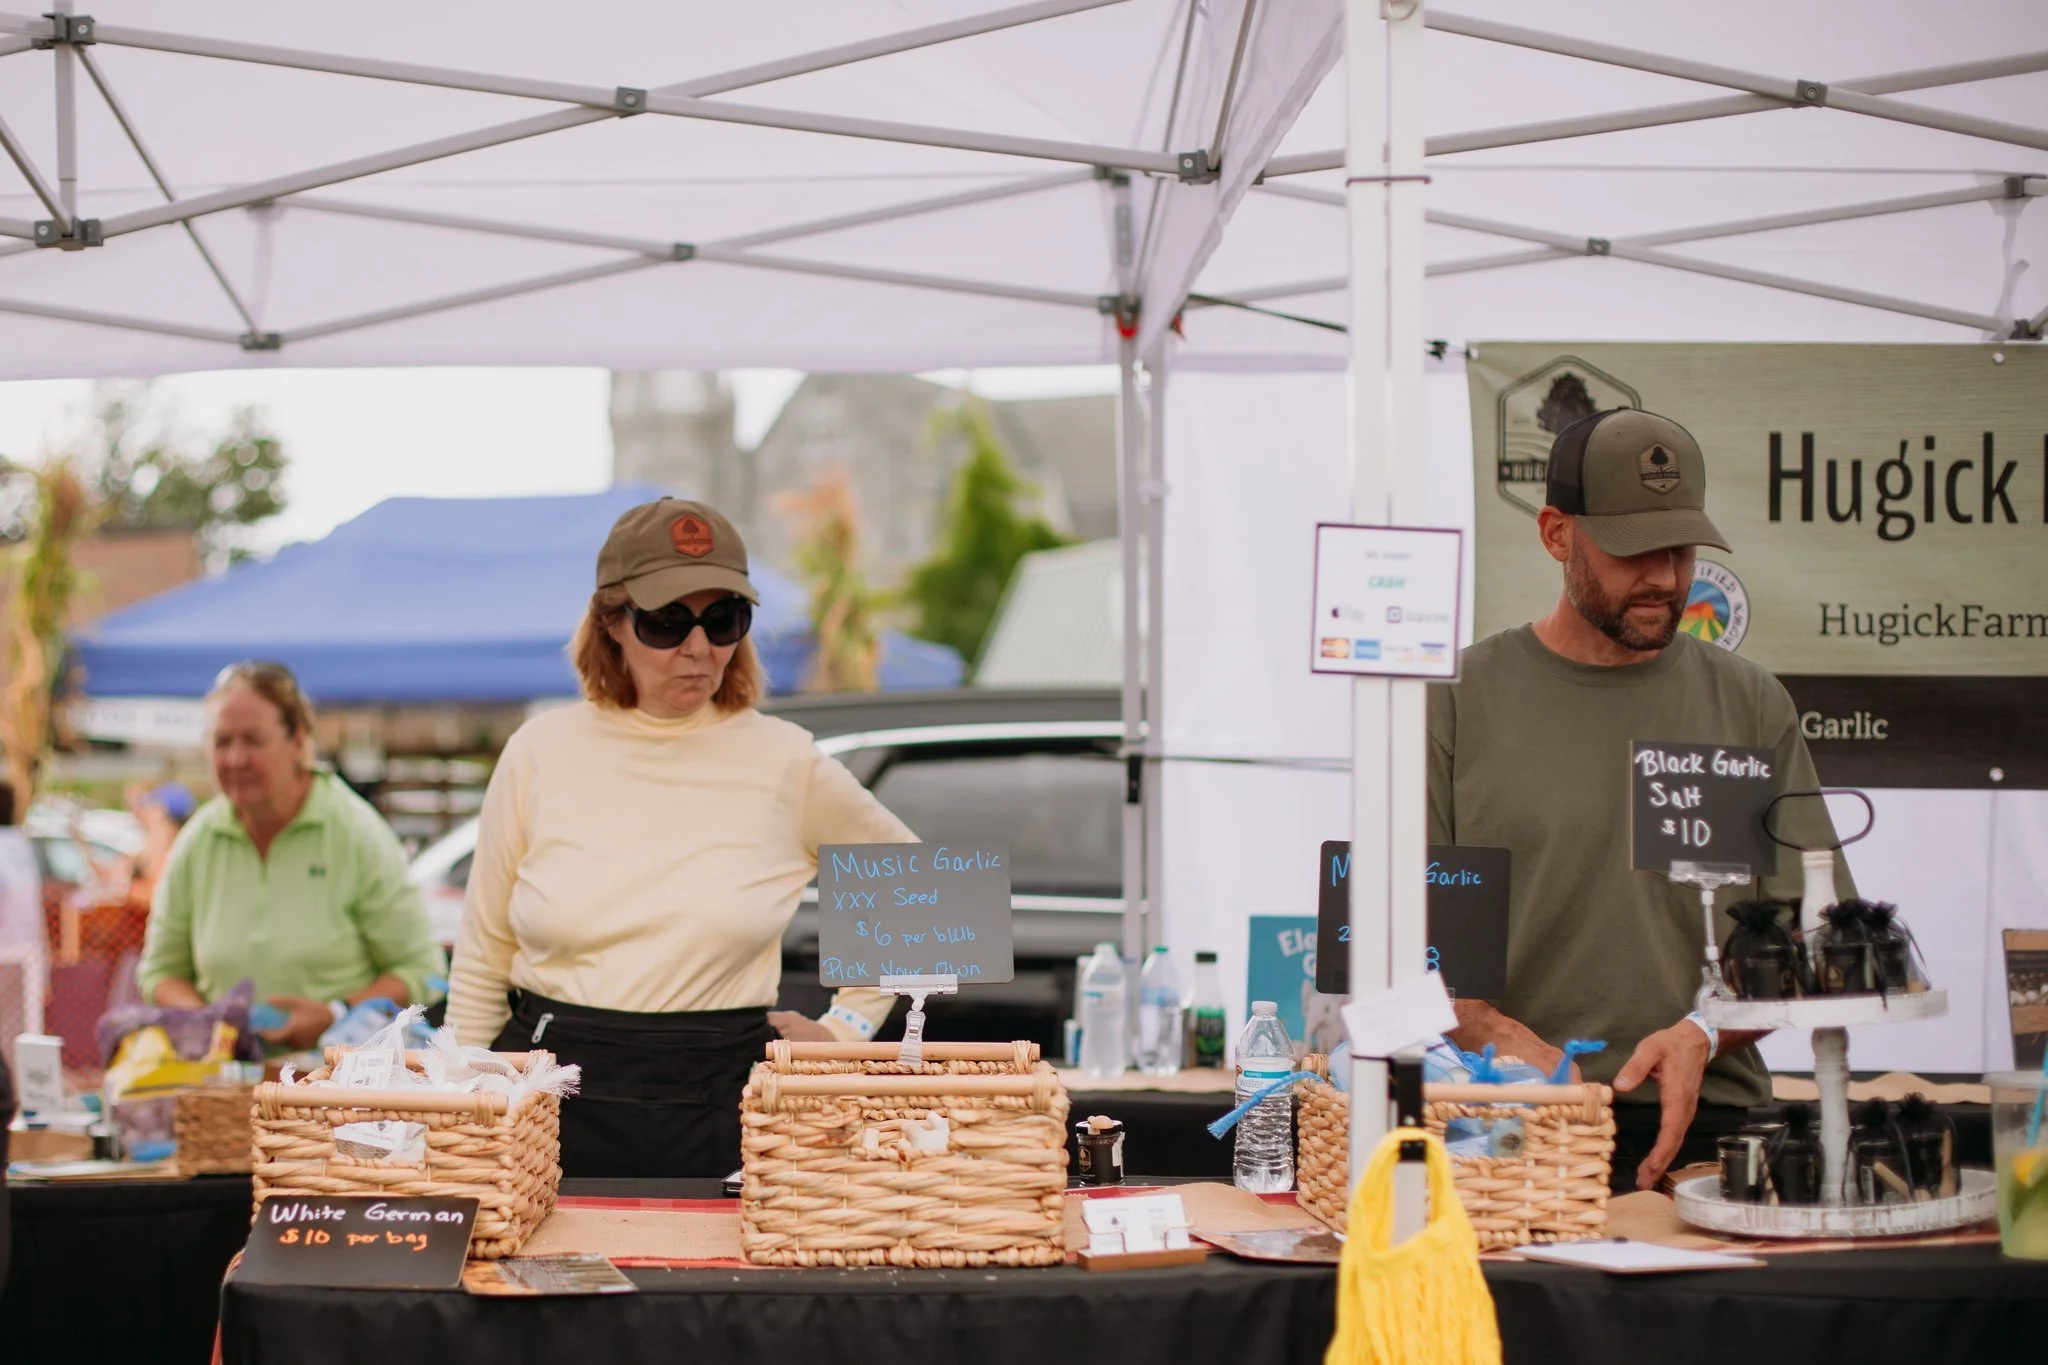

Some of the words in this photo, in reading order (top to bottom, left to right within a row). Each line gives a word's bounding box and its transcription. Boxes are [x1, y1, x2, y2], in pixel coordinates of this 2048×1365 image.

[1768, 432, 2018, 541] Hugick
[1801, 711, 1889, 740] Garlic
[1635, 750, 1706, 776] Black
[1712, 750, 1772, 778] Garlic
[1650, 782, 1703, 809] Salt
[1662, 818, 1711, 847] $10
[832, 853, 920, 882] Music
[934, 847, 1001, 872] Garlic
[1425, 861, 1482, 886] Garlic
[894, 887, 939, 906] Seed
[902, 932, 927, 947] per
[933, 926, 976, 944] bulb
[823, 957, 870, 981] Pick
[935, 961, 981, 976] Own
[270, 1203, 346, 1223] White
[364, 1202, 465, 1225] German
[279, 1229, 331, 1245] $10
[346, 1233, 380, 1246] per
[386, 1230, 428, 1251] bag
